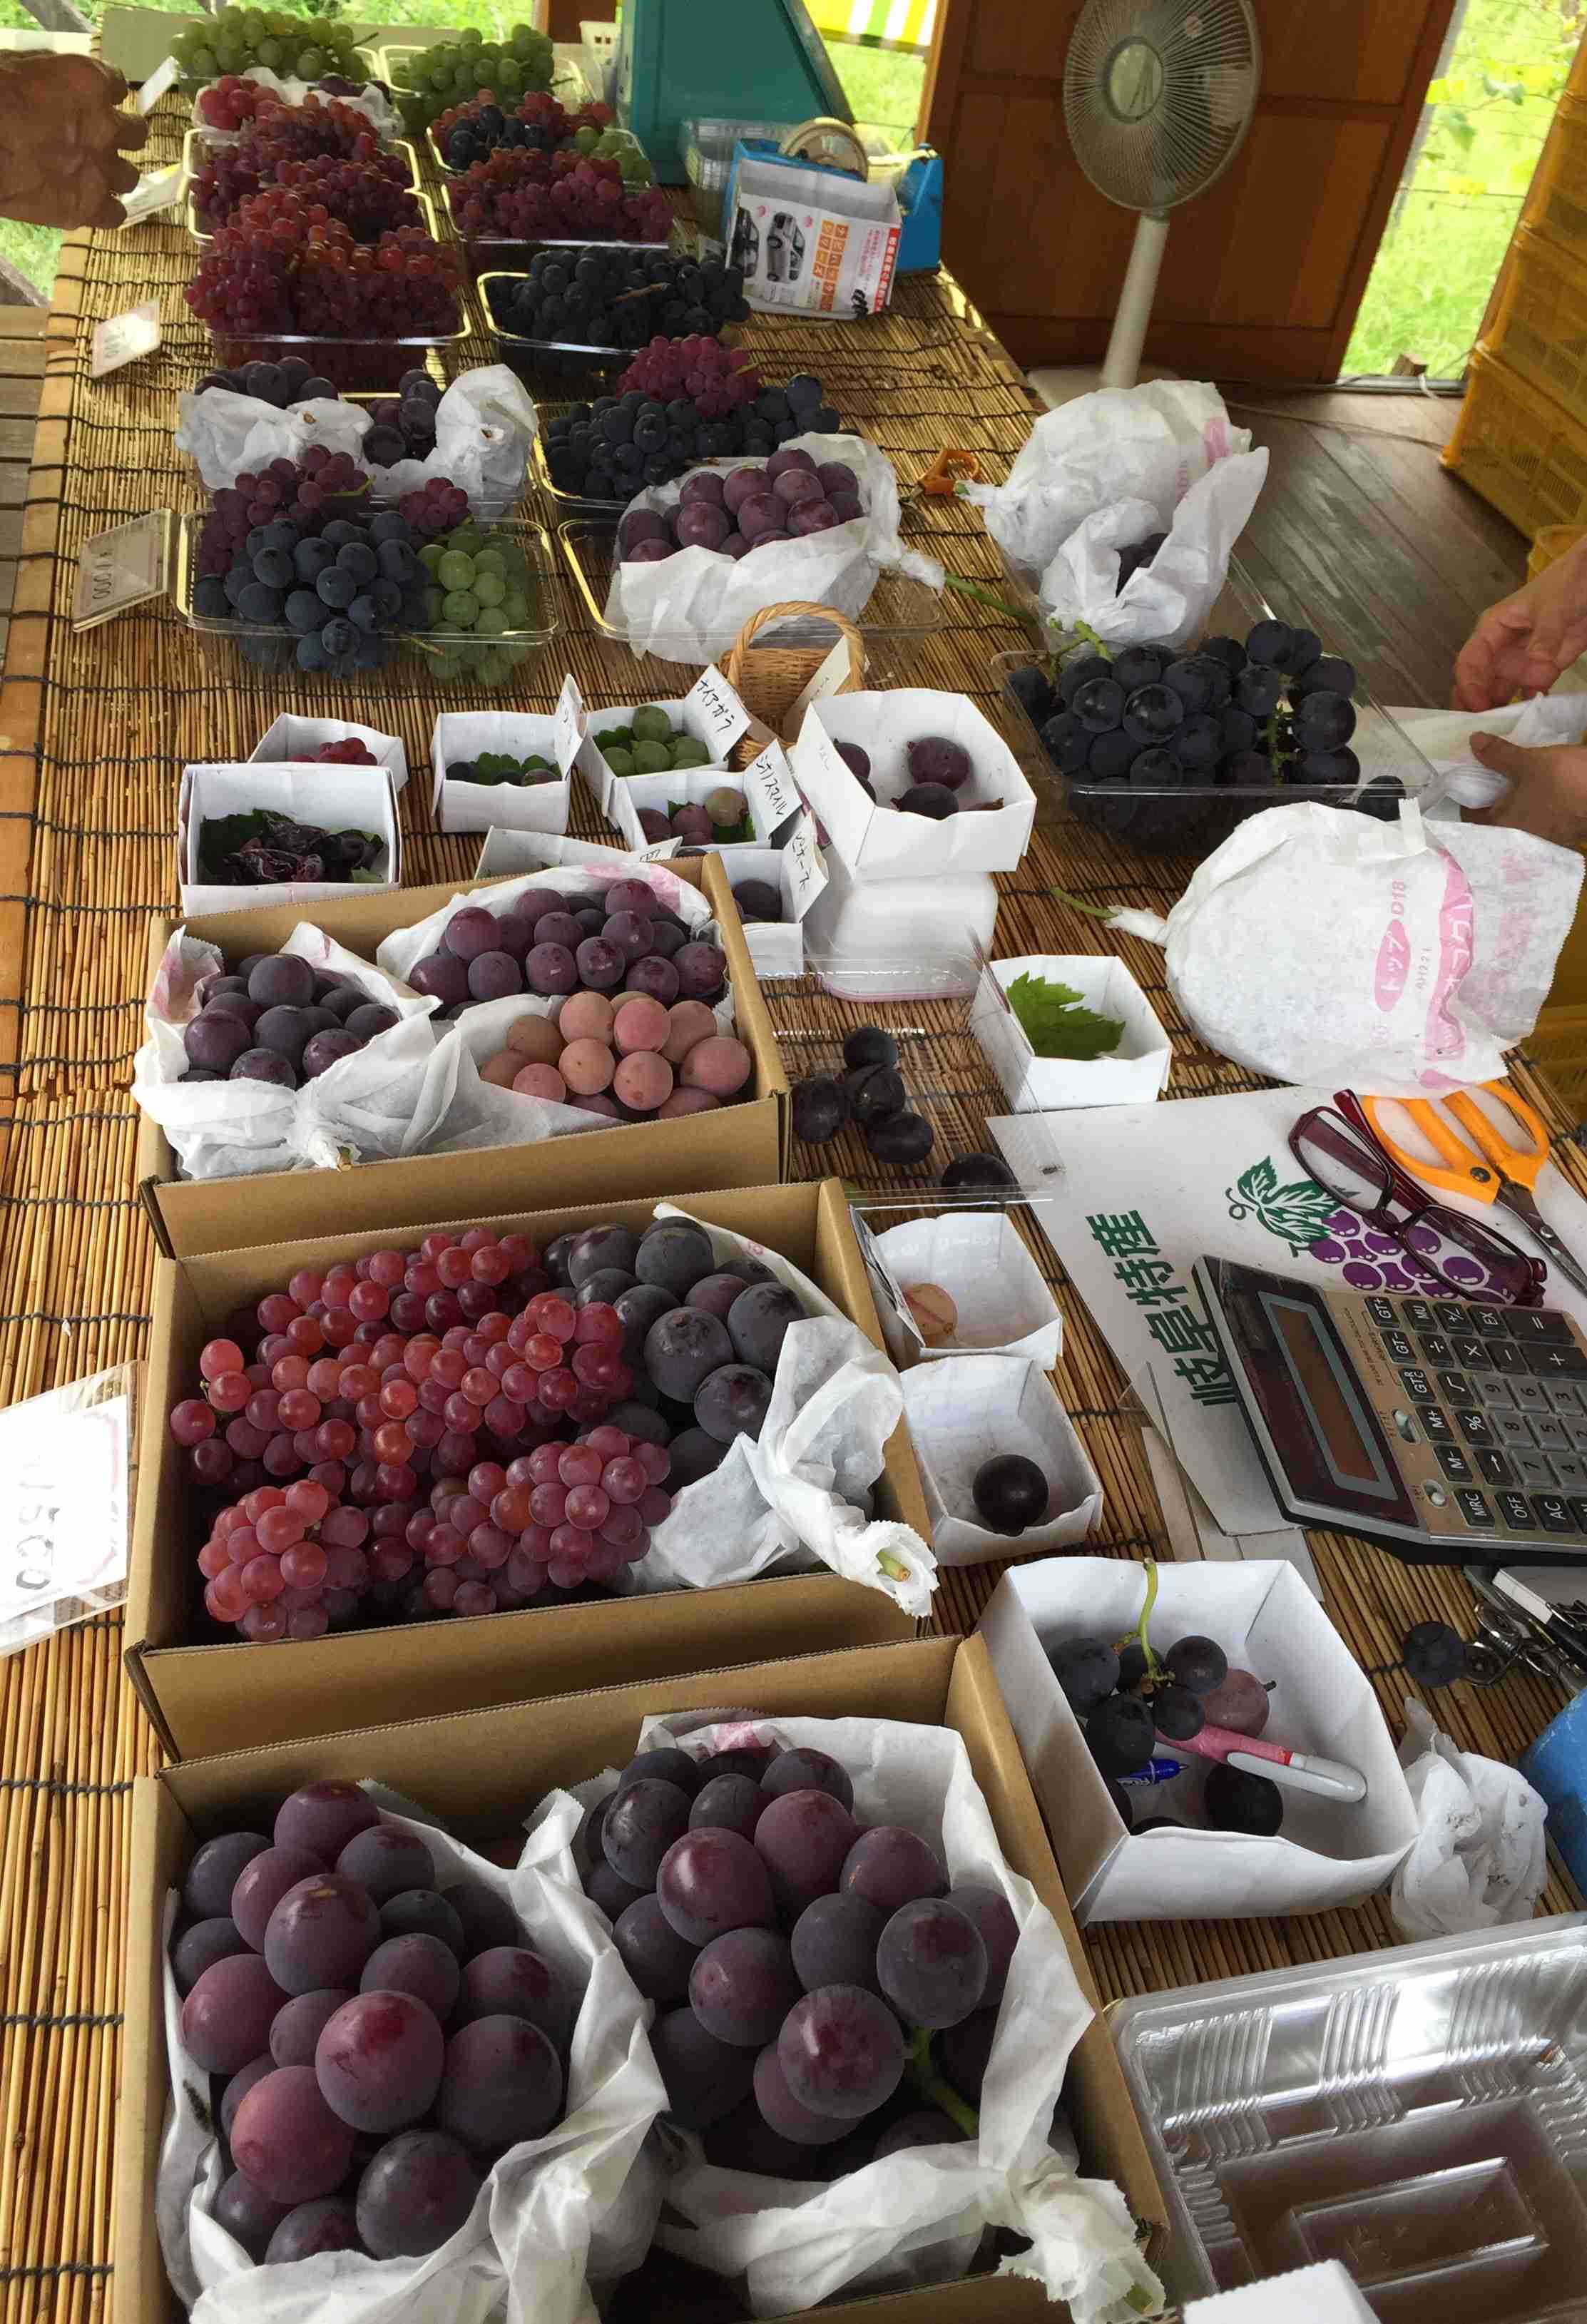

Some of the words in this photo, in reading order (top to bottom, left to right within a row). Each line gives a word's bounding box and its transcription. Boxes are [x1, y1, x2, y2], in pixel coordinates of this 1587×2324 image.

[1381, 929, 1405, 992] トップ
[1085, 1210, 1238, 1407] 岐阜特産
[1465, 1492, 1487, 1517] MRC
[1507, 1495, 1528, 1519] OFF
[1543, 1501, 1567, 1520] AC
